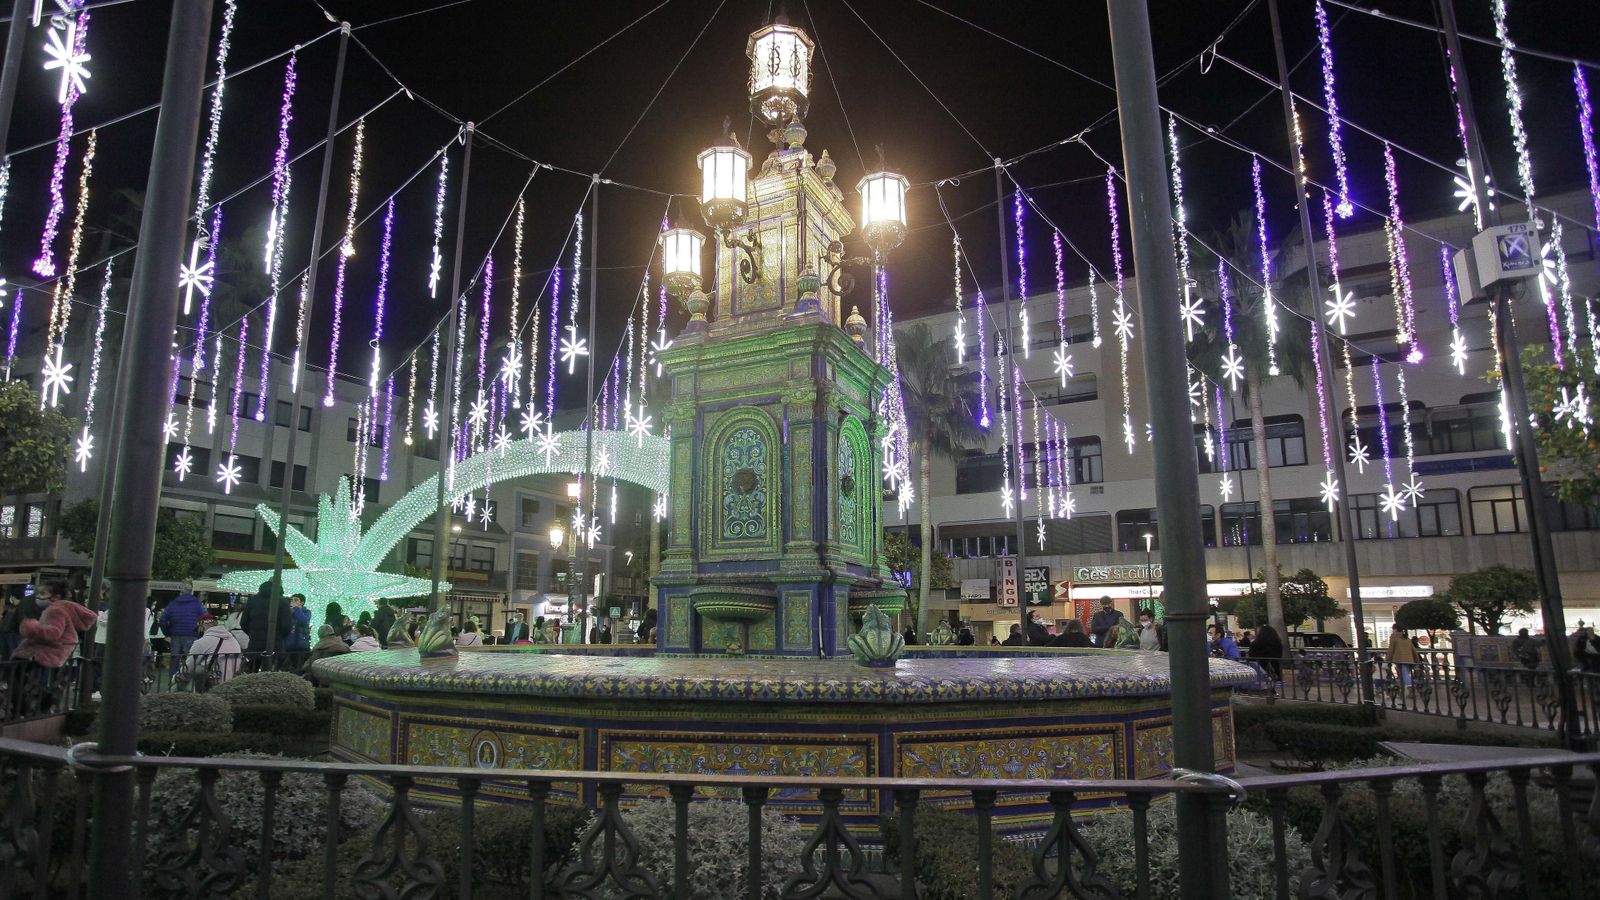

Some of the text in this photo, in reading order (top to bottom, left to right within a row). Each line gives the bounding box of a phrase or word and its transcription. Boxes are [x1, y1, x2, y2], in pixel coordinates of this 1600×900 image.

[1024, 568, 1047, 582] SEX
[1004, 560, 1016, 605] BINGO
[1024, 582, 1048, 593] SHOP
